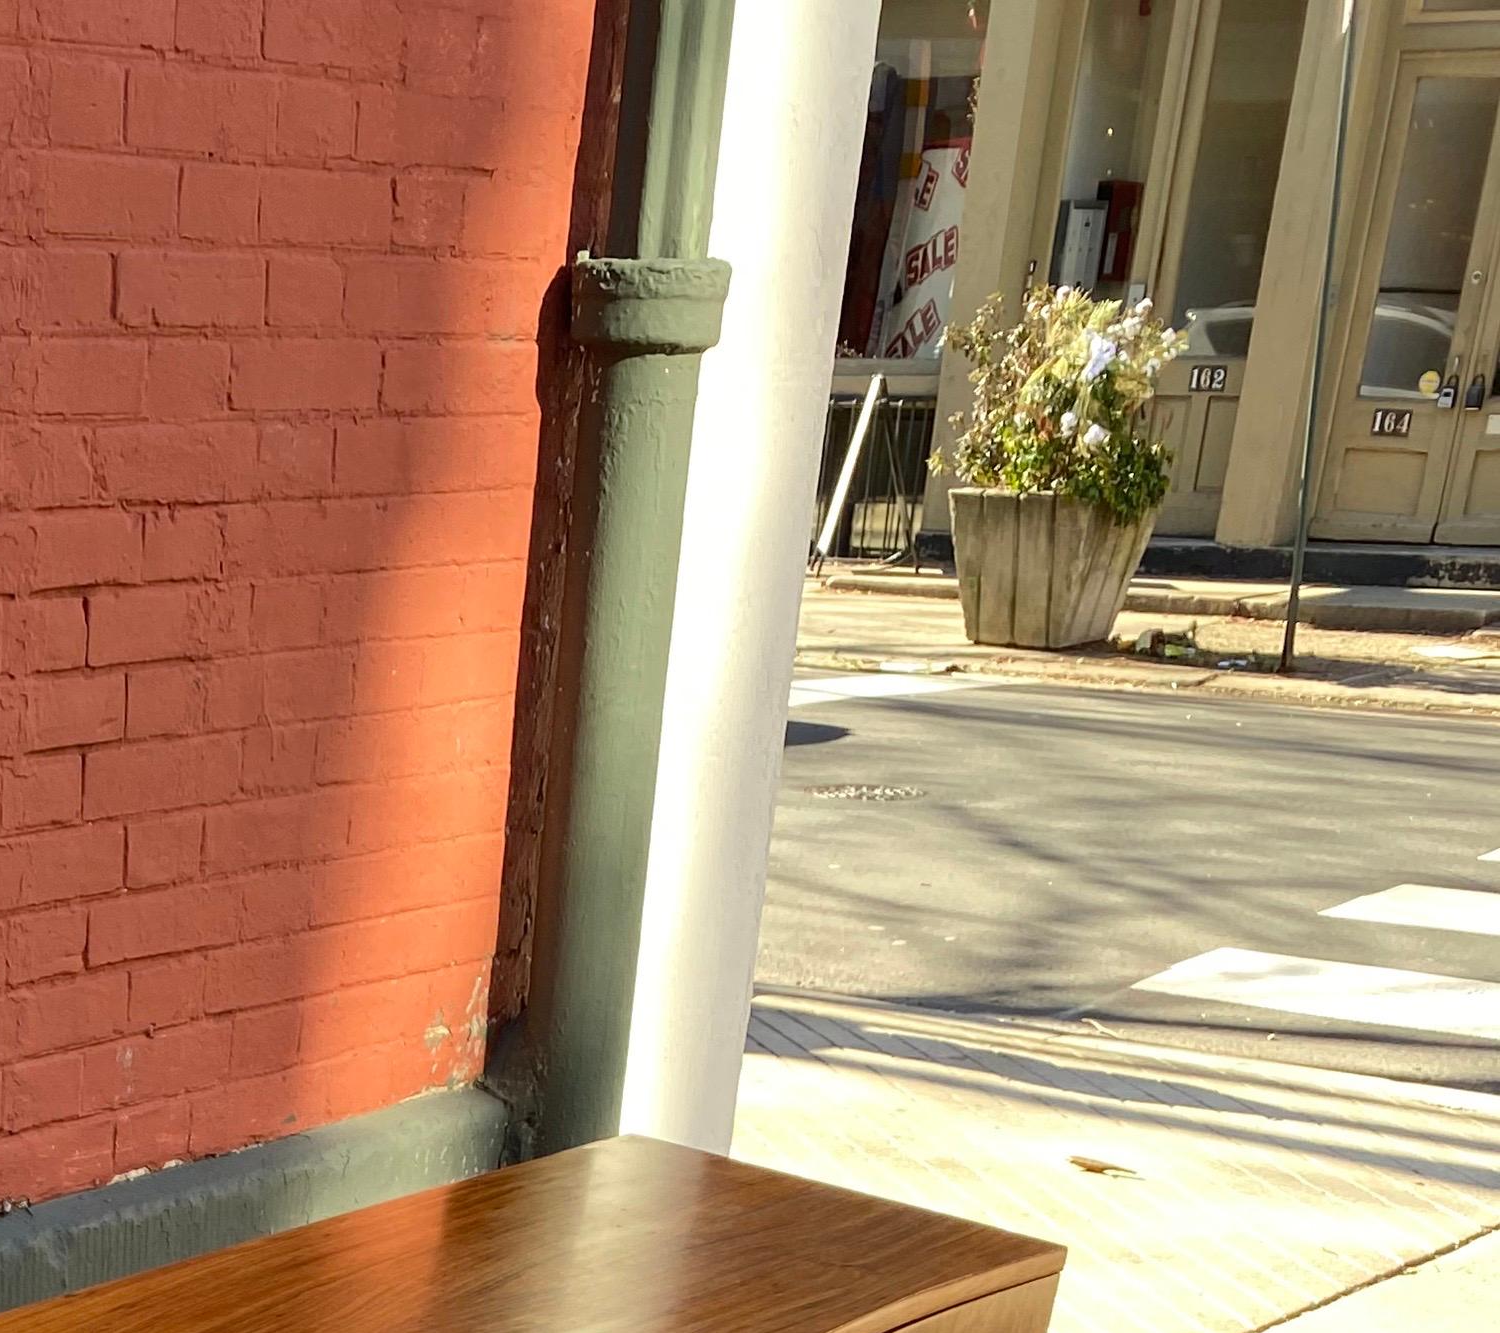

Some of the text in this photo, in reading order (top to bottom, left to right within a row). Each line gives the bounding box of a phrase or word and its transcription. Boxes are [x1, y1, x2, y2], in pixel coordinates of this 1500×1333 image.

[905, 225, 958, 287] SALE
[1190, 367, 1226, 390] 162
[1372, 410, 1411, 433] 164
